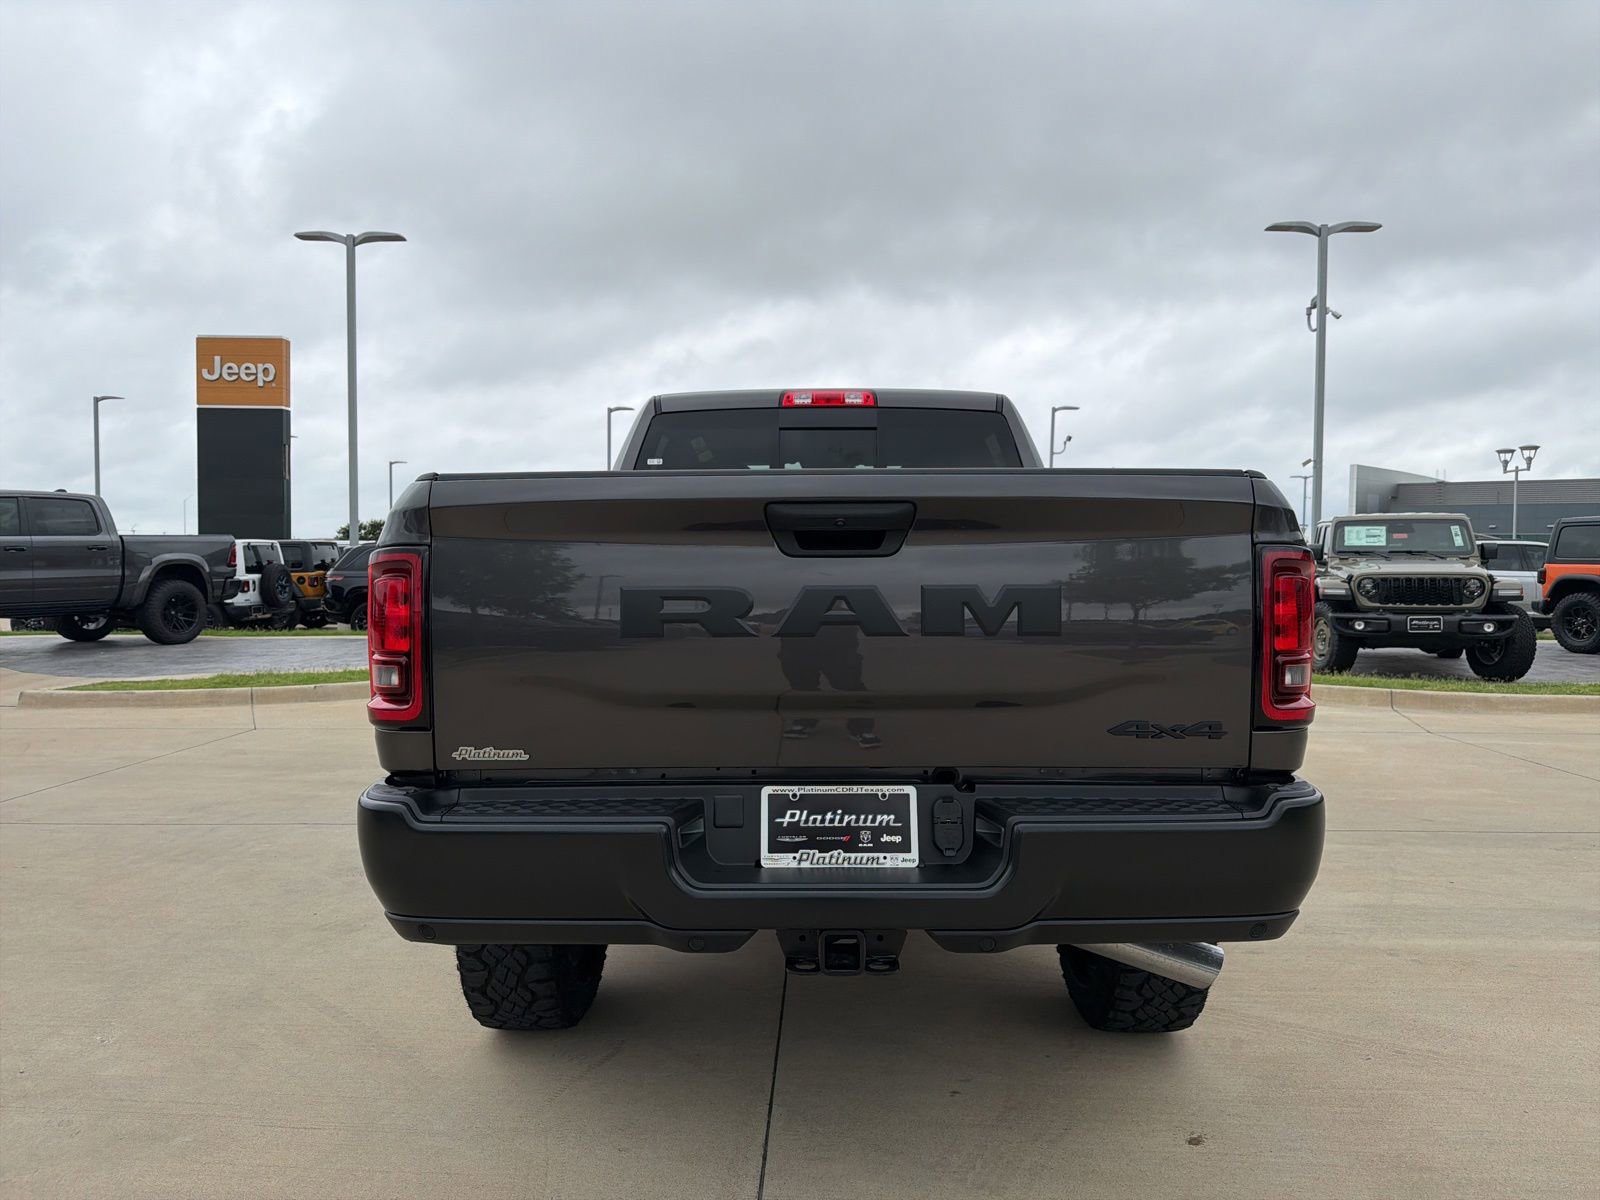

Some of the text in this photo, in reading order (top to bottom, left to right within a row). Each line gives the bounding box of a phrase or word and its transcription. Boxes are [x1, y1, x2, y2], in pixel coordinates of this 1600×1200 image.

[201, 355, 277, 387] Jeep
[620, 584, 1062, 637] RAM
[451, 746, 530, 760] Platinum
[774, 809, 903, 827] Platinum
[880, 833, 902, 843] Jeep
[796, 851, 887, 866] Platinum
